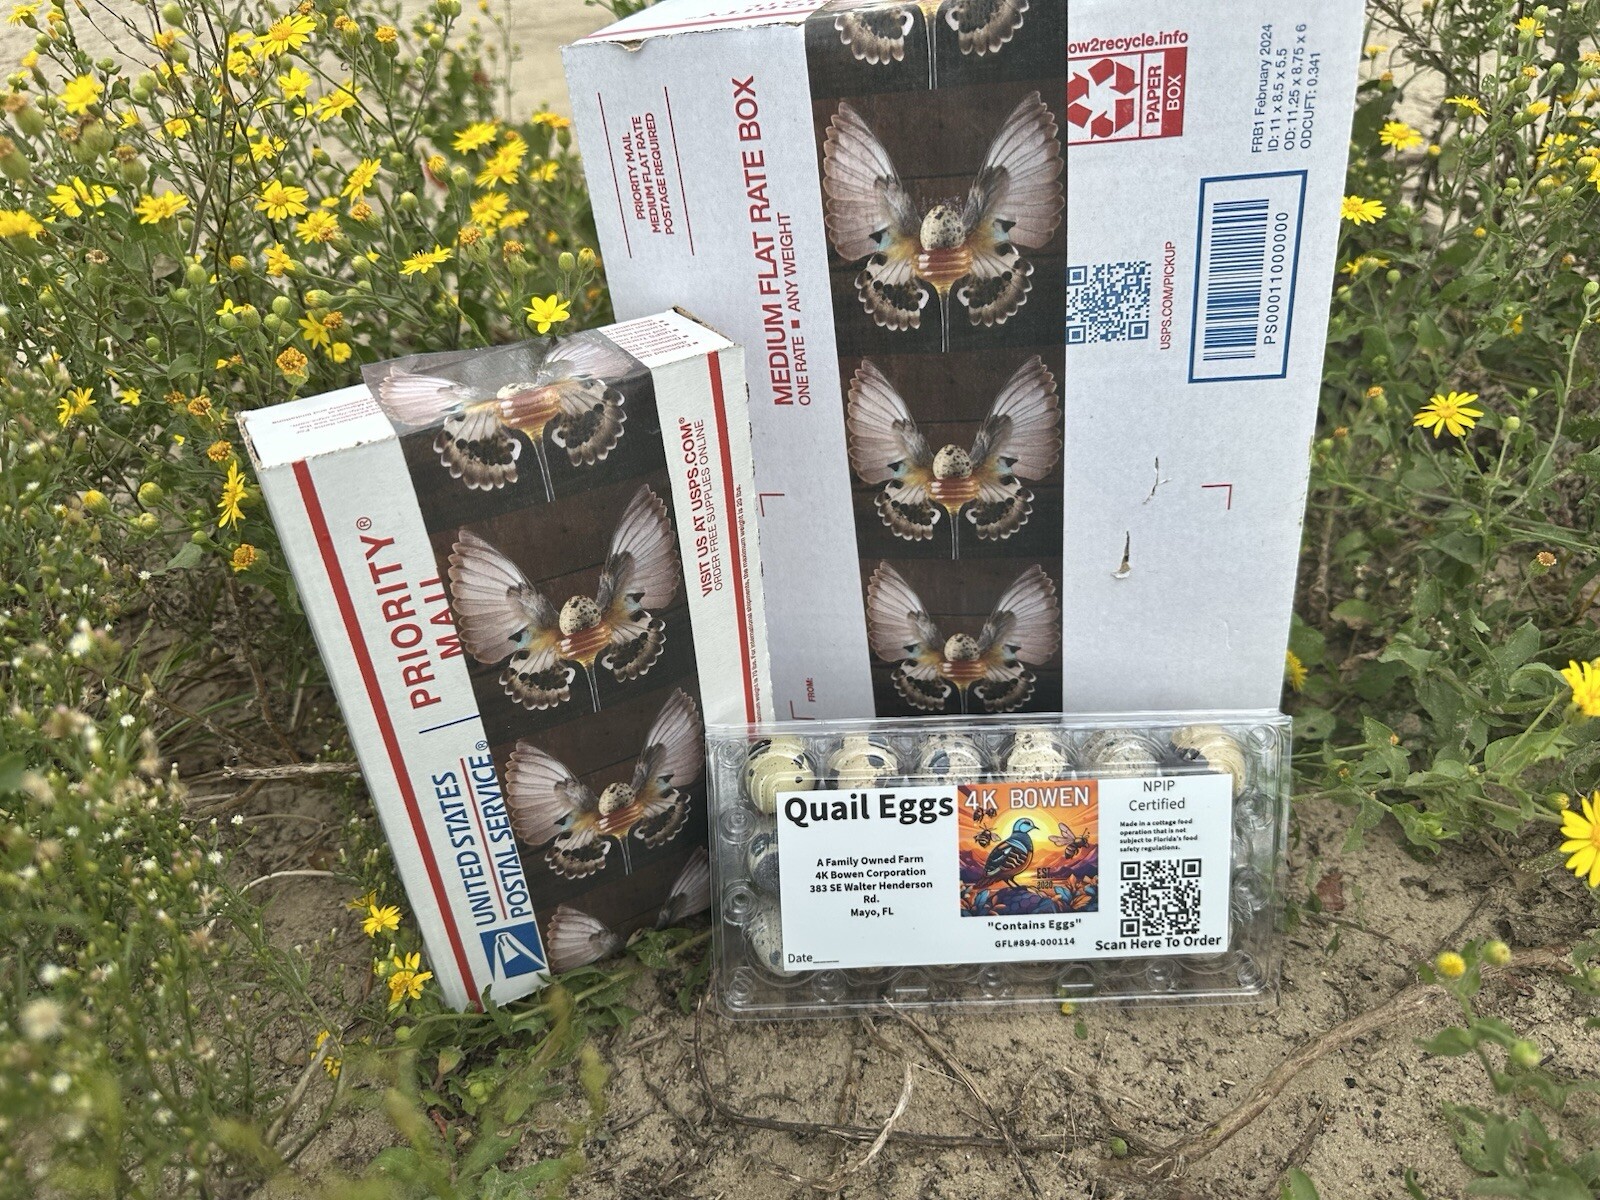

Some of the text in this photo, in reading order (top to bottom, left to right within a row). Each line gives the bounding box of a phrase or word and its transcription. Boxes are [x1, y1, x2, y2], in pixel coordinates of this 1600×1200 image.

[1068, 30, 1188, 54] ow2recycle.info
[1146, 65, 1162, 123] PAPER
[1166, 74, 1182, 111] BOX
[1252, 24, 1272, 153] FRB1 February 2024
[1284, 23, 1307, 150] OD: 11.25 x 8.75 x 6
[1268, 48, 1287, 152] ID: 11 x 8.5 x 5.5
[1300, 52, 1321, 149] ODCUFT: 0.341
[622, 132, 646, 220] PRIORITY MAIL
[631, 116, 661, 234] MEDIUM FLAT RATE
[645, 112, 675, 235] POSTAGE REQUIRED
[731, 75, 793, 405] MEDIUM FLAT RATE BOX
[1263, 212, 1289, 345] PS00011000000
[1160, 241, 1176, 350] USPS.COM/PICKUP
[777, 212, 811, 406] ONE RATE ANY WEIGHT
[694, 419, 723, 591] ORDER FREE SUPPLIES ONLINE
[693, 515, 706, 532] AT
[695, 535, 708, 560] US
[699, 562, 713, 598] VISIT
[807, 677, 816, 703] FROM:
[965, 786, 1090, 810] 4K BOWEN
[1143, 780, 1175, 792] NPIP
[784, 793, 954, 828] Quail Eggs
[1129, 798, 1185, 812] Certified
[1120, 829, 1152, 837] operation
[1152, 819, 1176, 828] cottage
[431, 770, 497, 926] UNITED STATES
[1120, 836, 1144, 845] subject
[1153, 835, 1182, 843] Florida's
[1120, 843, 1181, 853] safety regulations.
[815, 868, 926, 880] 4K Bowen Corporation
[816, 855, 924, 868] A Family Owned Farm
[497, 843, 533, 918] POSTAL
[809, 880, 933, 893] 383 SE Walter Henderson
[863, 895, 880, 904] Rd.
[850, 907, 894, 919] Mayo, FL
[988, 918, 1082, 931] "Contains Eggs"
[995, 937, 1075, 948] GFL#894-000114
[1095, 934, 1222, 952] Scan Here To Order
